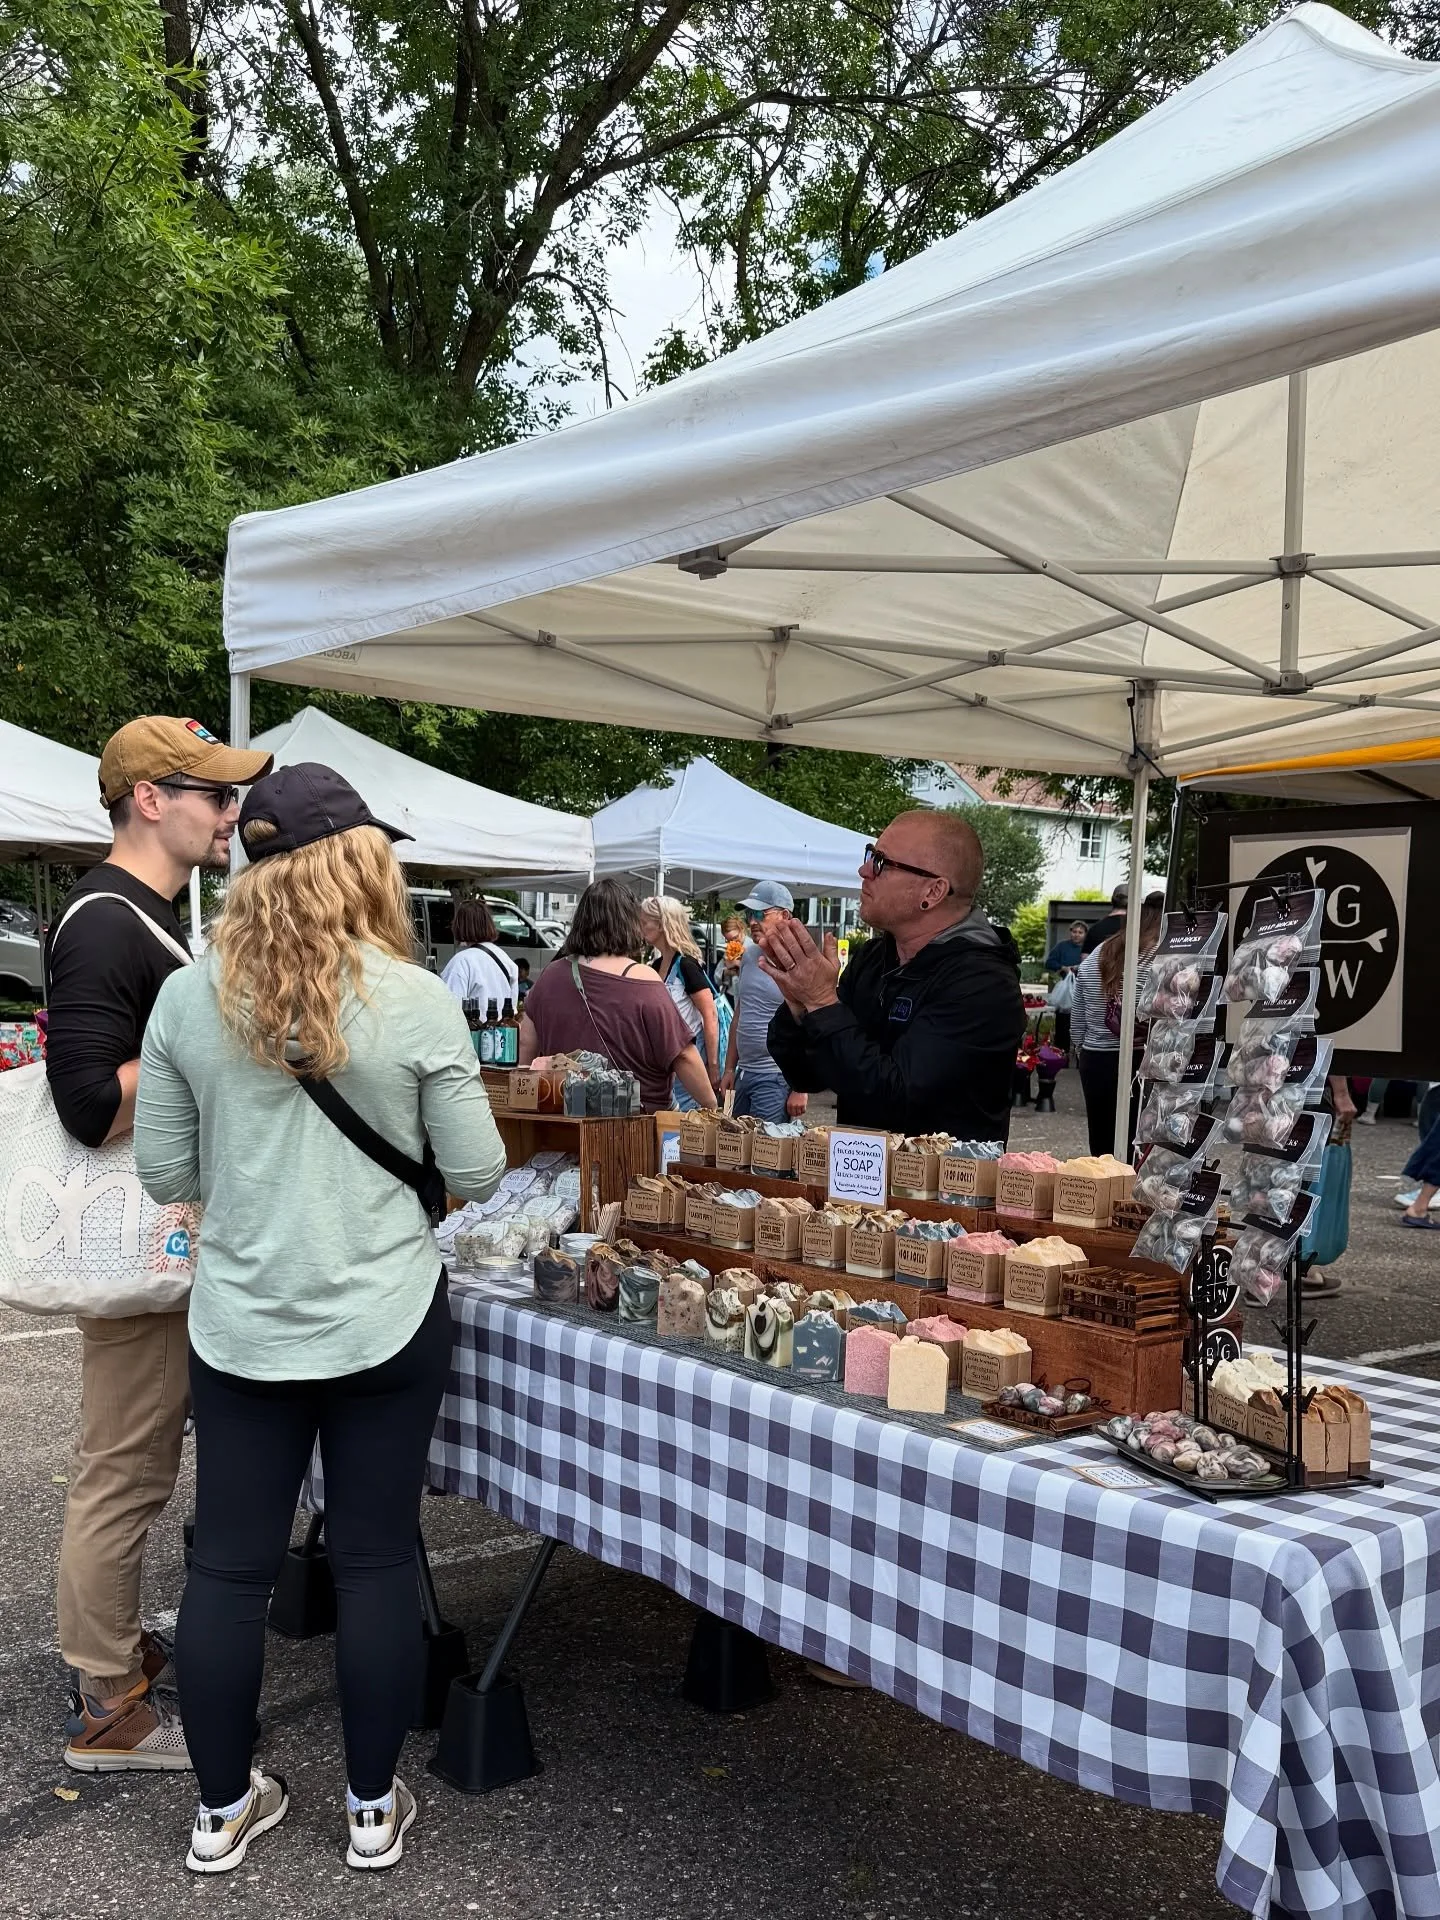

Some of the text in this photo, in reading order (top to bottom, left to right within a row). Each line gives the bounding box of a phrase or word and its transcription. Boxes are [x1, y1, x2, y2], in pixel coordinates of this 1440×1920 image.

[1327, 884, 1360, 928] G
[1324, 960, 1362, 999] W
[844, 1158, 874, 1172] SOAP
[1218, 1261, 1228, 1278] G
